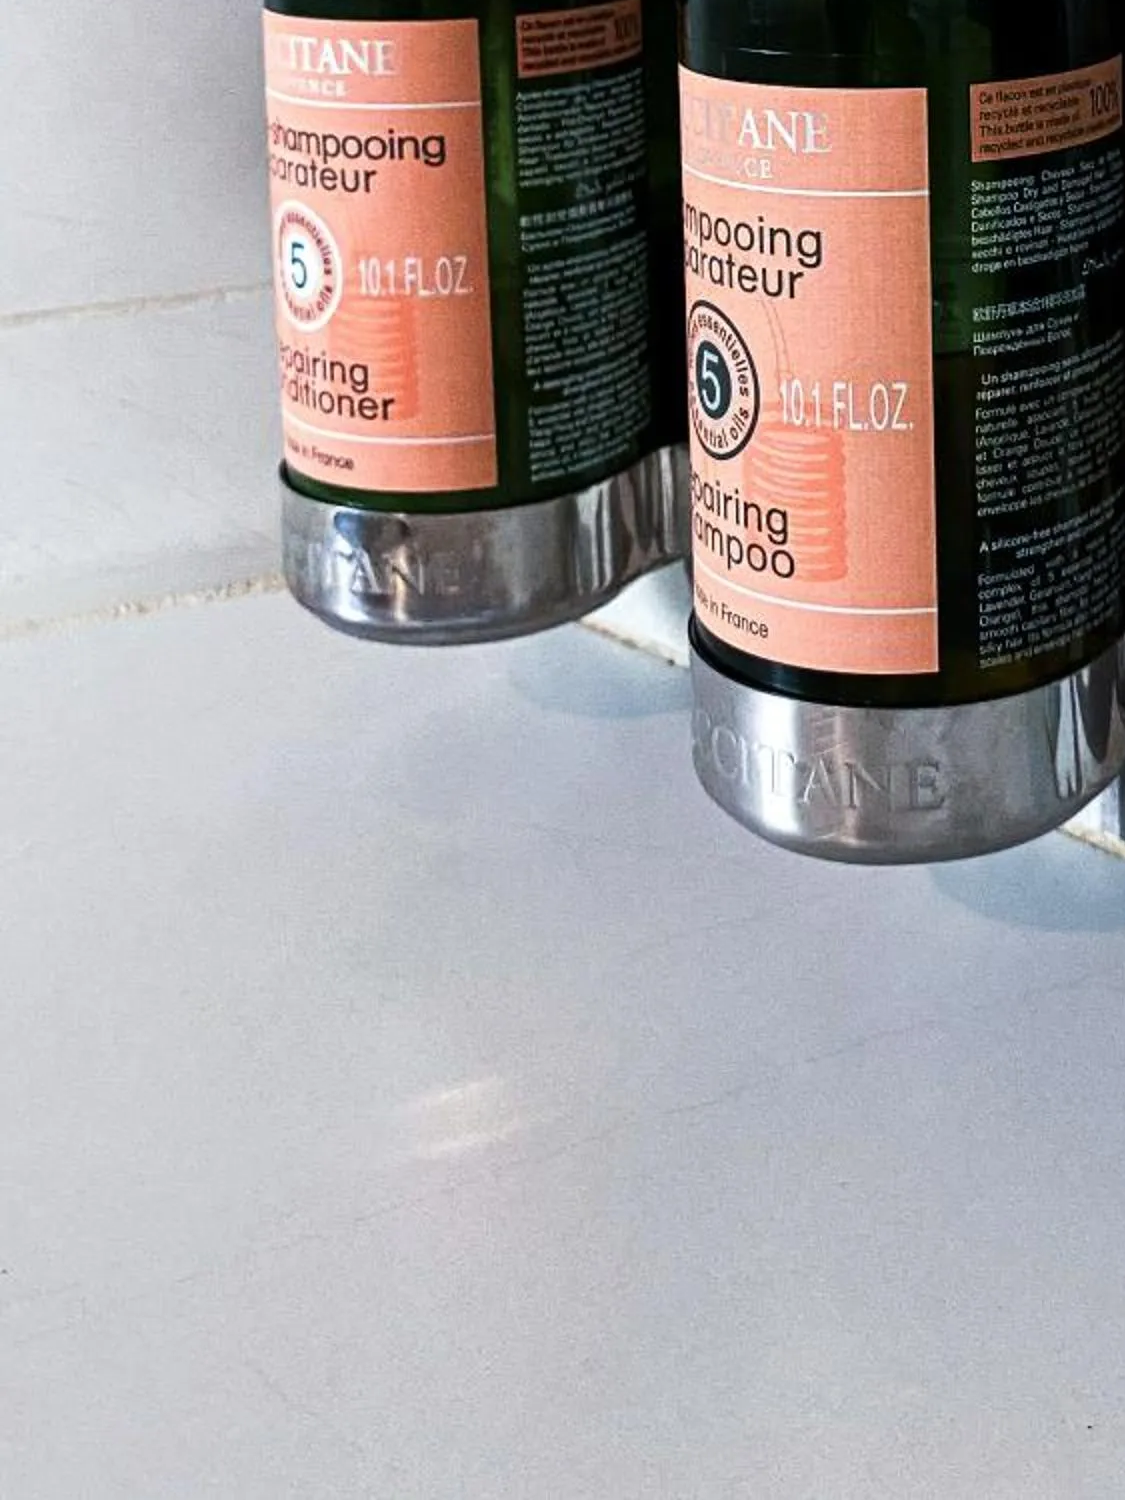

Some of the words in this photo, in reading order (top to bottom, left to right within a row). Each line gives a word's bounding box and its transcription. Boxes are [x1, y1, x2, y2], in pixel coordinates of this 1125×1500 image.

[979, 125, 1003, 138] This
[291, 241, 307, 288] 5
[358, 257, 395, 296] 10.1
[701, 350, 721, 411] 5
[981, 373, 999, 386] Un
[779, 379, 821, 427] 10.1
[721, 603, 769, 639] France
